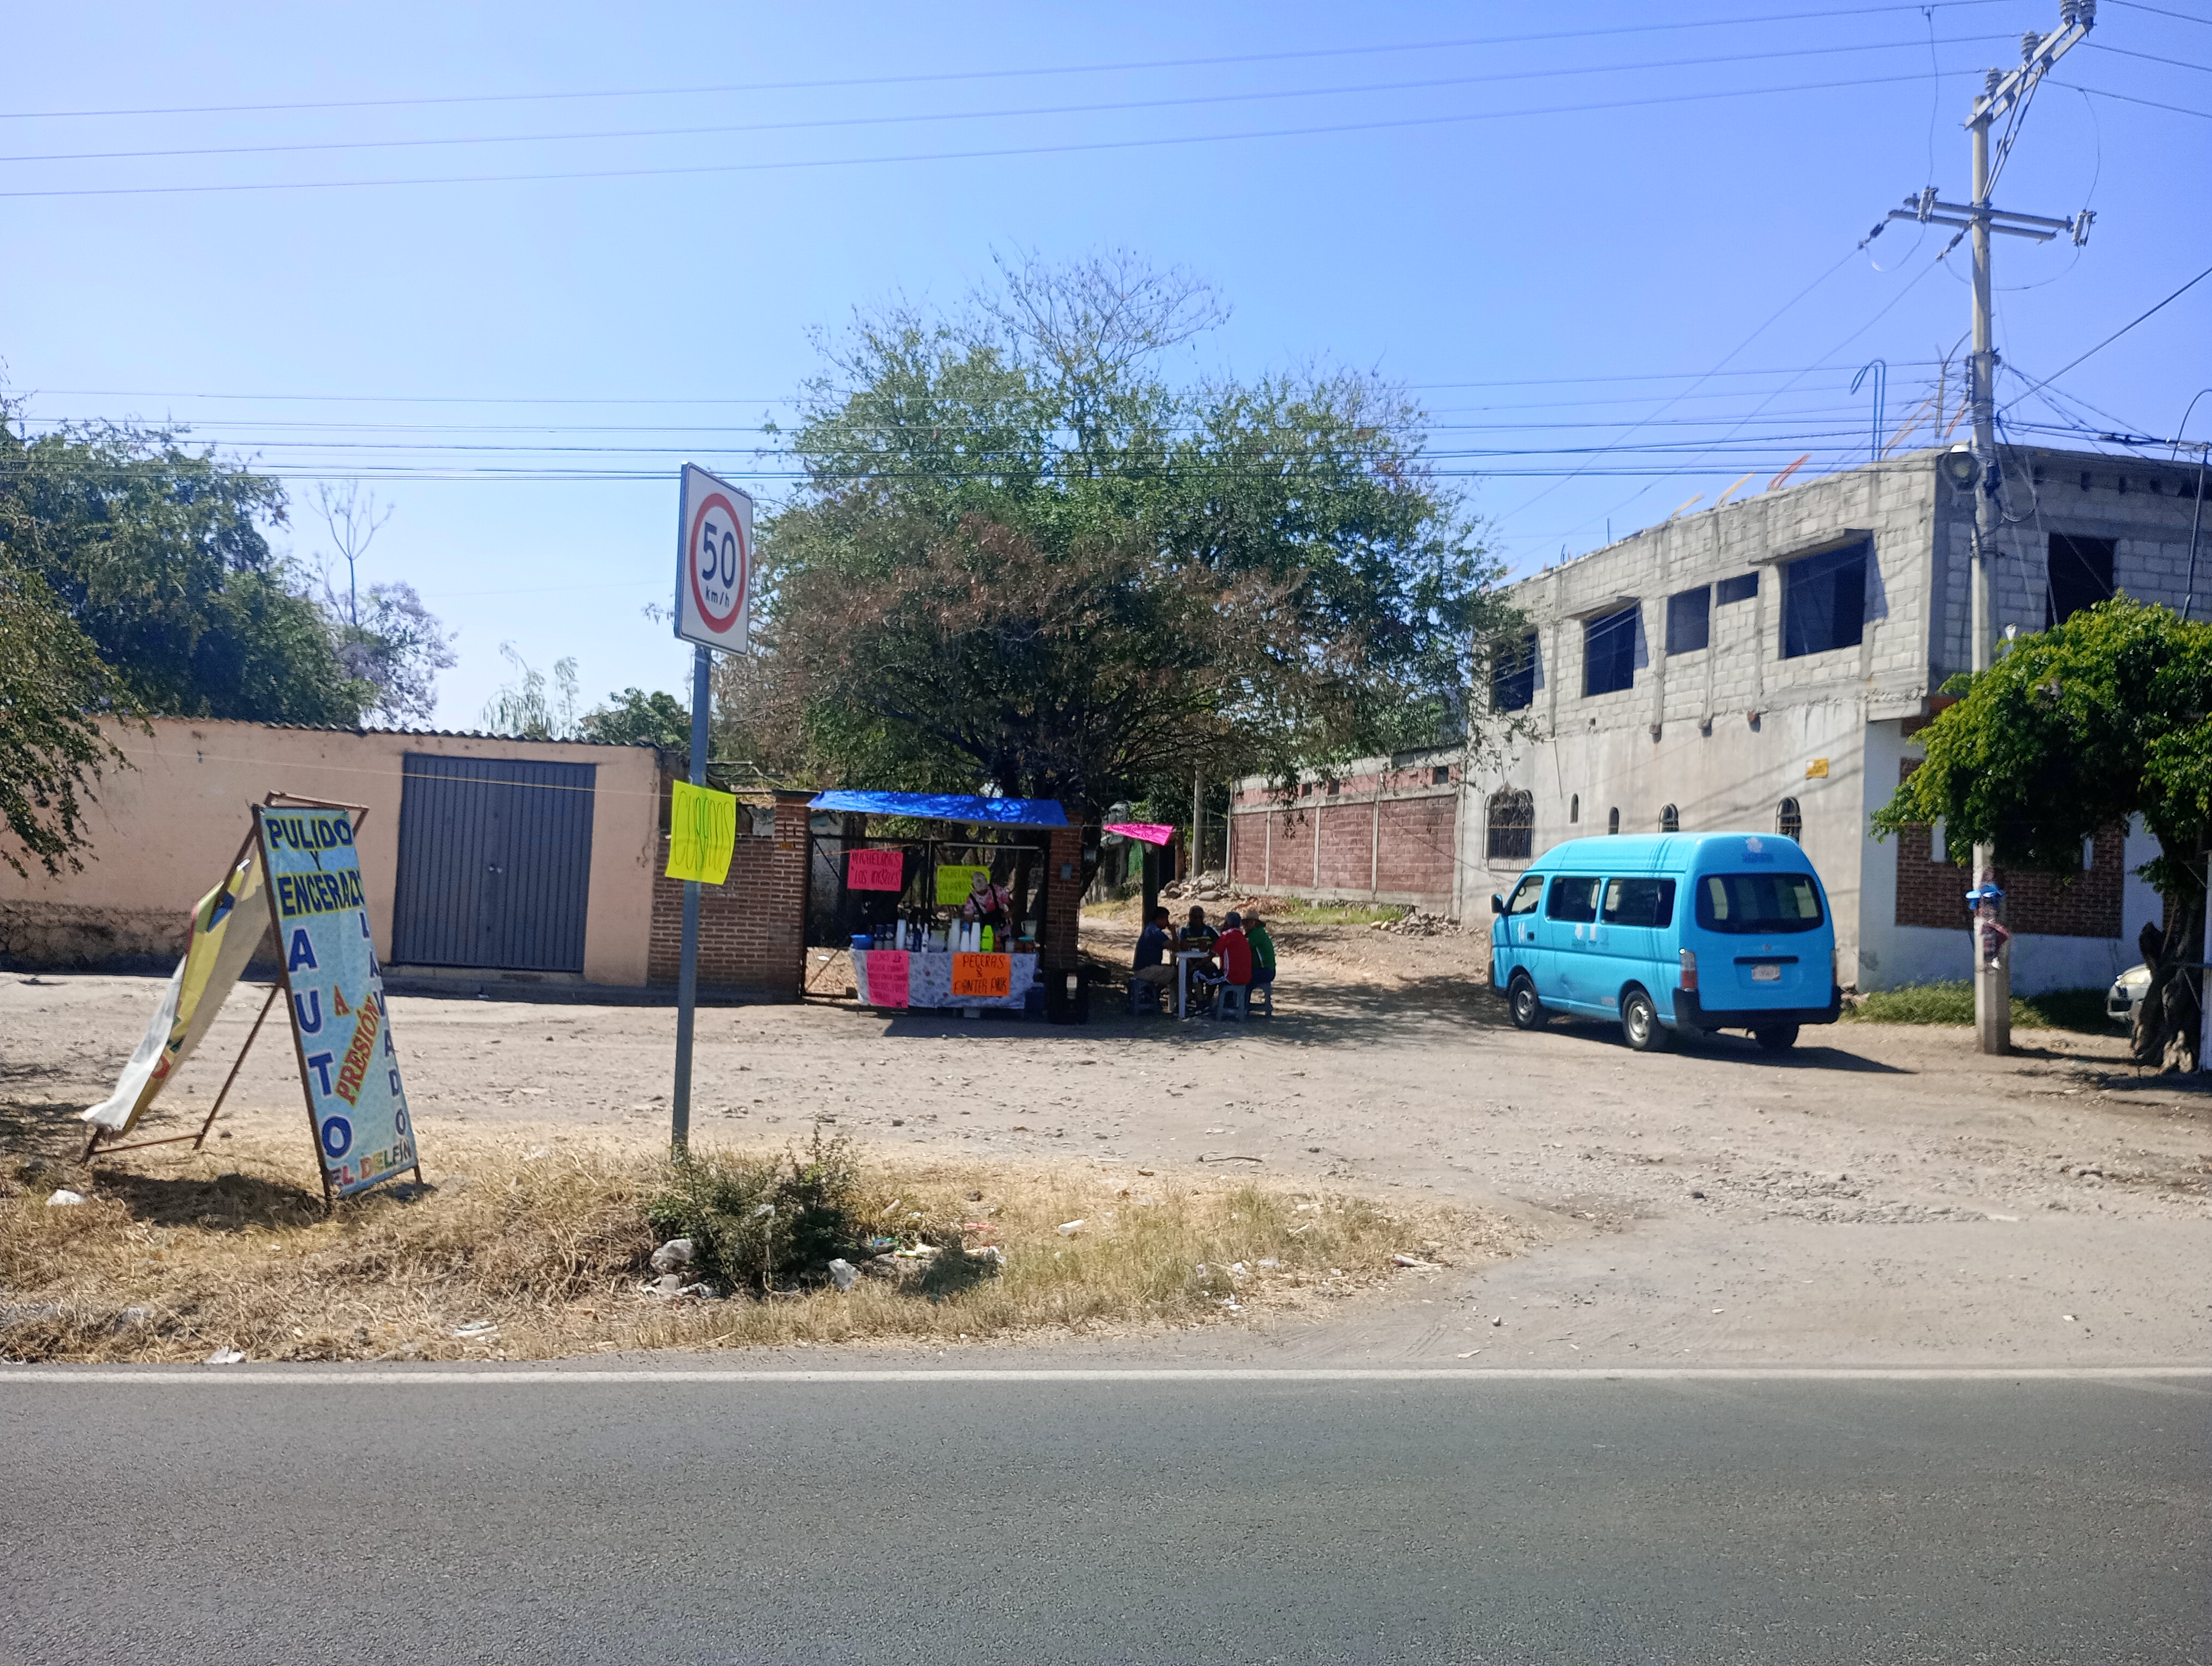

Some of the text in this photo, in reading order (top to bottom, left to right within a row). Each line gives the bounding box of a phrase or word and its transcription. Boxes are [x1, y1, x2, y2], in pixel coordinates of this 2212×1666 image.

[702, 522, 736, 589] 50
[706, 586, 729, 607] km/h
[266, 819, 352, 849] PULIDO
[310, 850, 321, 872] Y
[334, 984, 351, 1017] A
[288, 930, 352, 1158] AUTO
[336, 994, 379, 1106] PRESIÓN
[330, 1166, 355, 1187] EL
